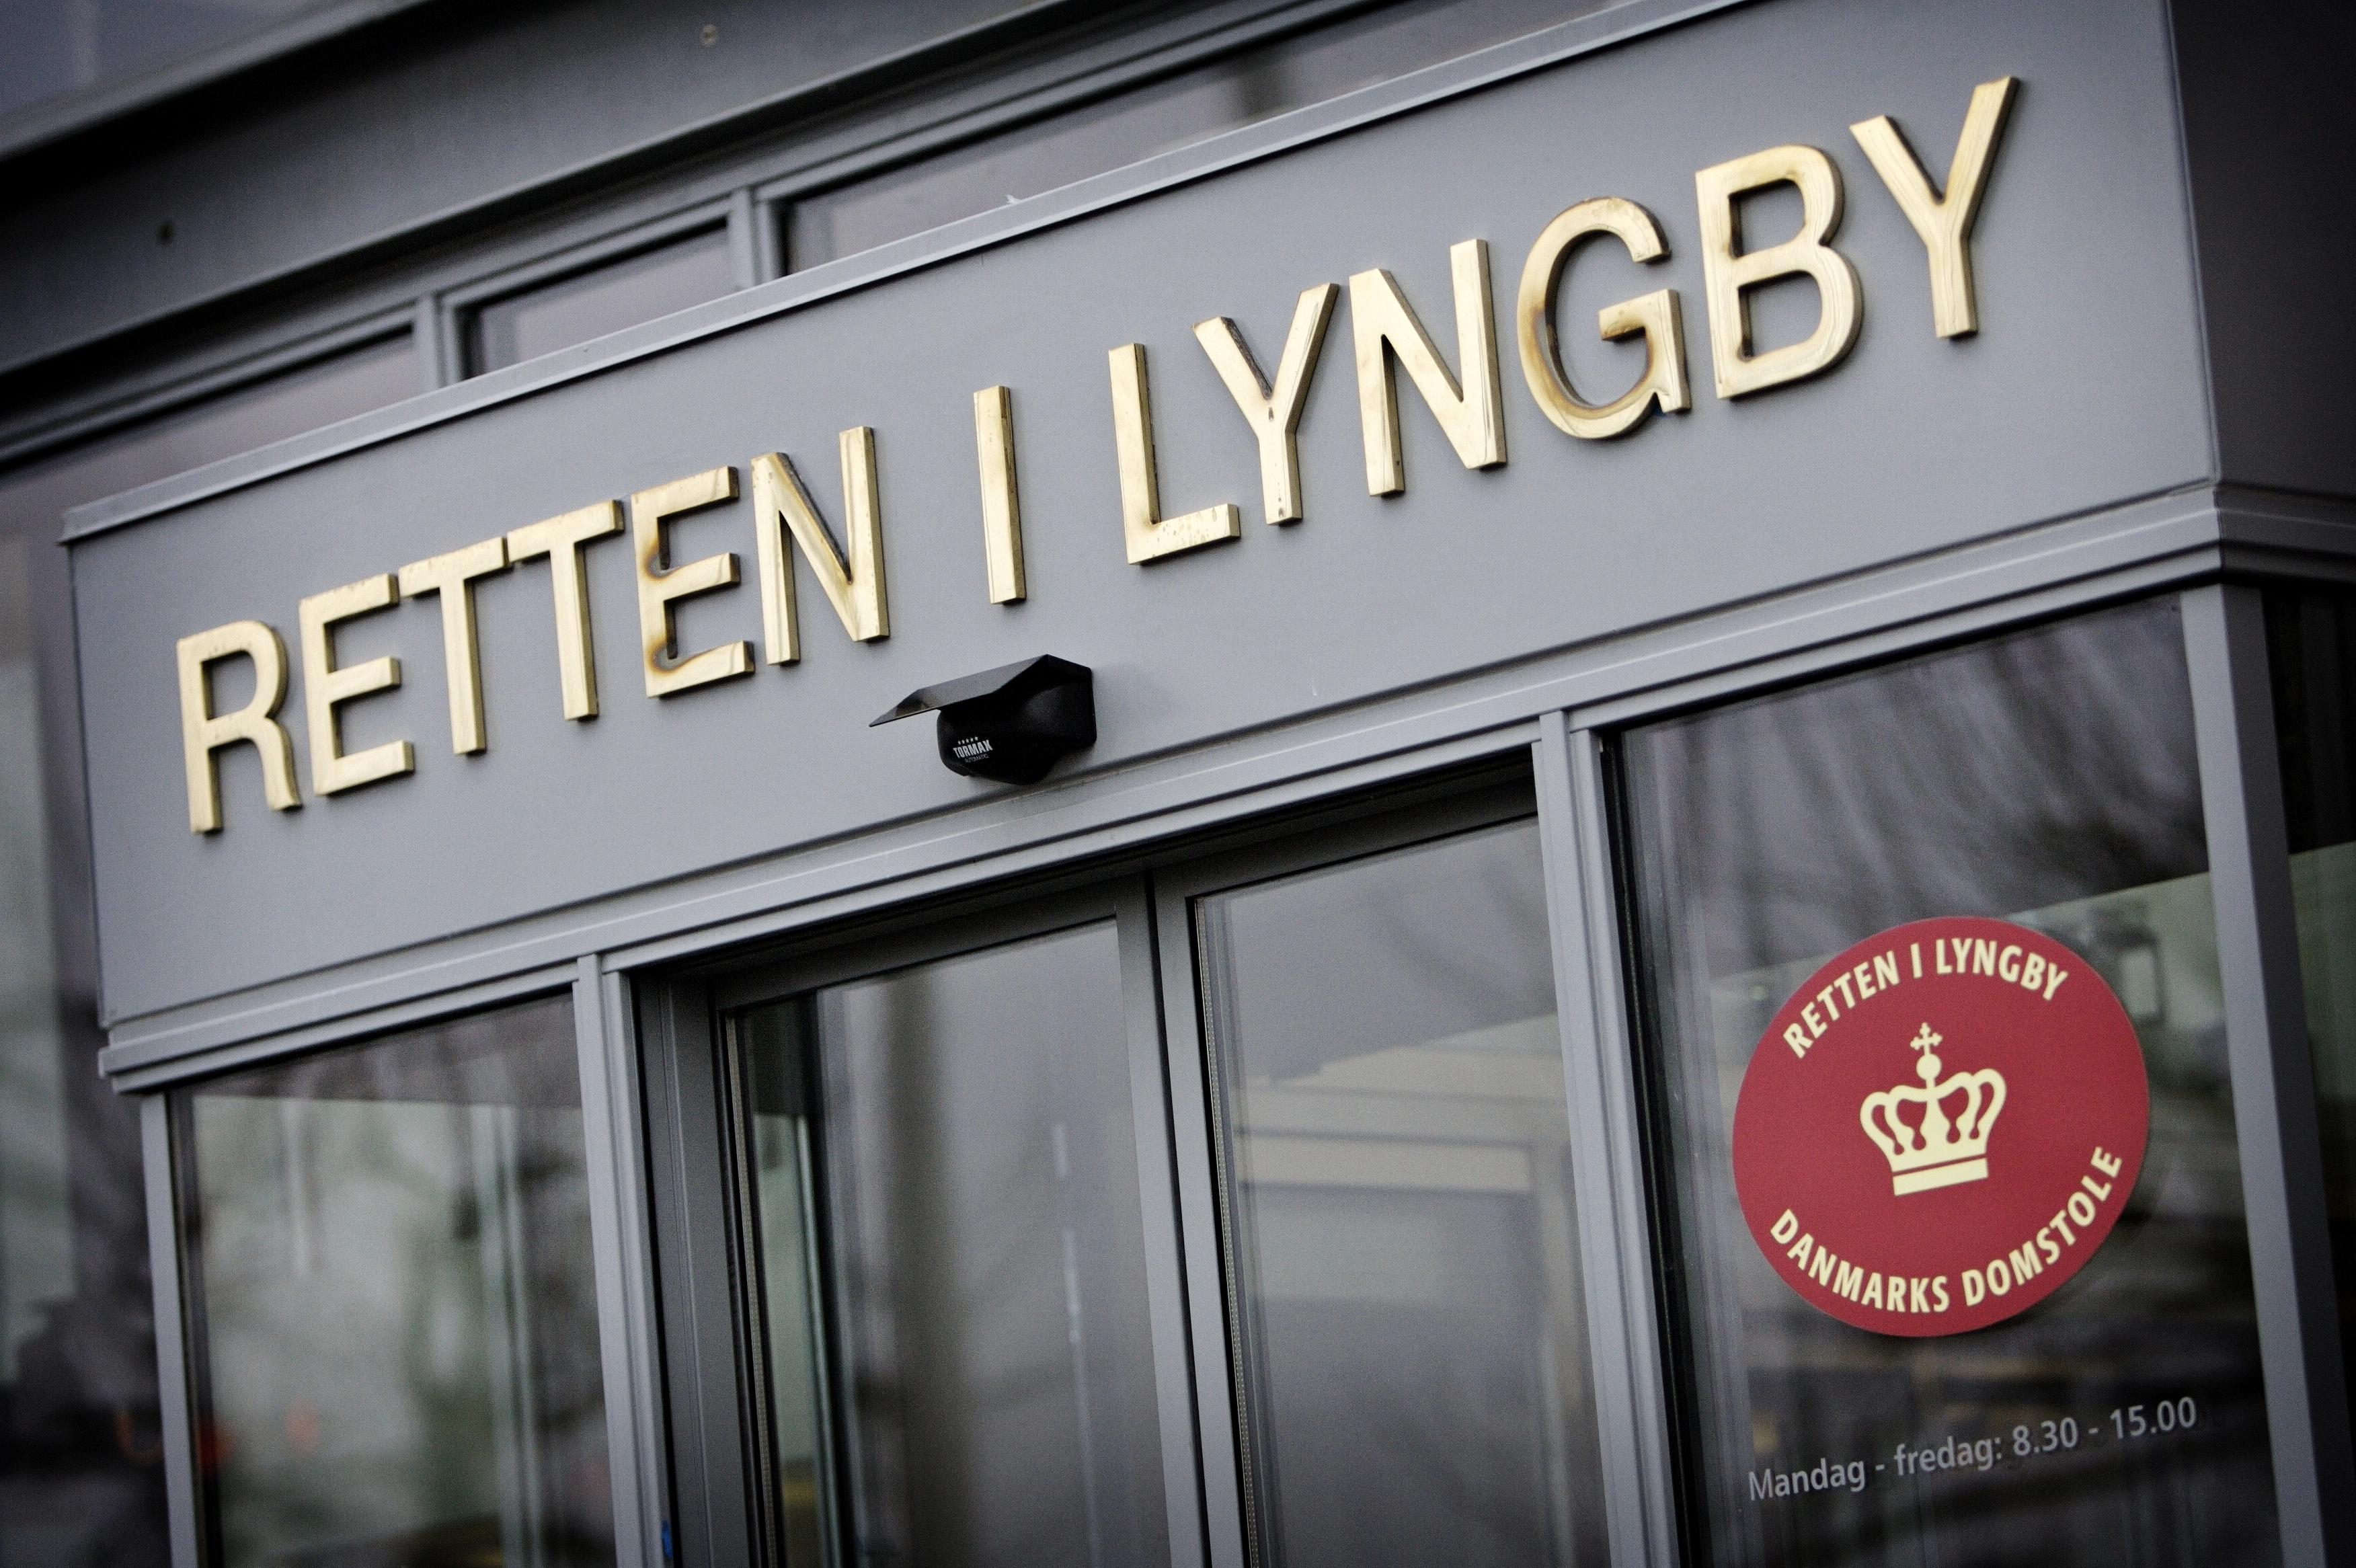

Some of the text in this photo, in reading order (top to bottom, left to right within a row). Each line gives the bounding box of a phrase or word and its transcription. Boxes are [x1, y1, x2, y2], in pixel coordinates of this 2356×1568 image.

[176, 75, 2018, 835] RETTEN I LYNGBY
[953, 740, 993, 758] TORMAX
[1783, 937, 2068, 1059] RETTEN I LYNGBY
[1770, 1146, 2123, 1313] DANMARKS DOMSTOLE
[1748, 1458, 1865, 1501] Mandag
[1893, 1436, 2003, 1476] fredag:
[2012, 1416, 2078, 1456] 8.30
[2110, 1396, 2197, 1440] 15.00
